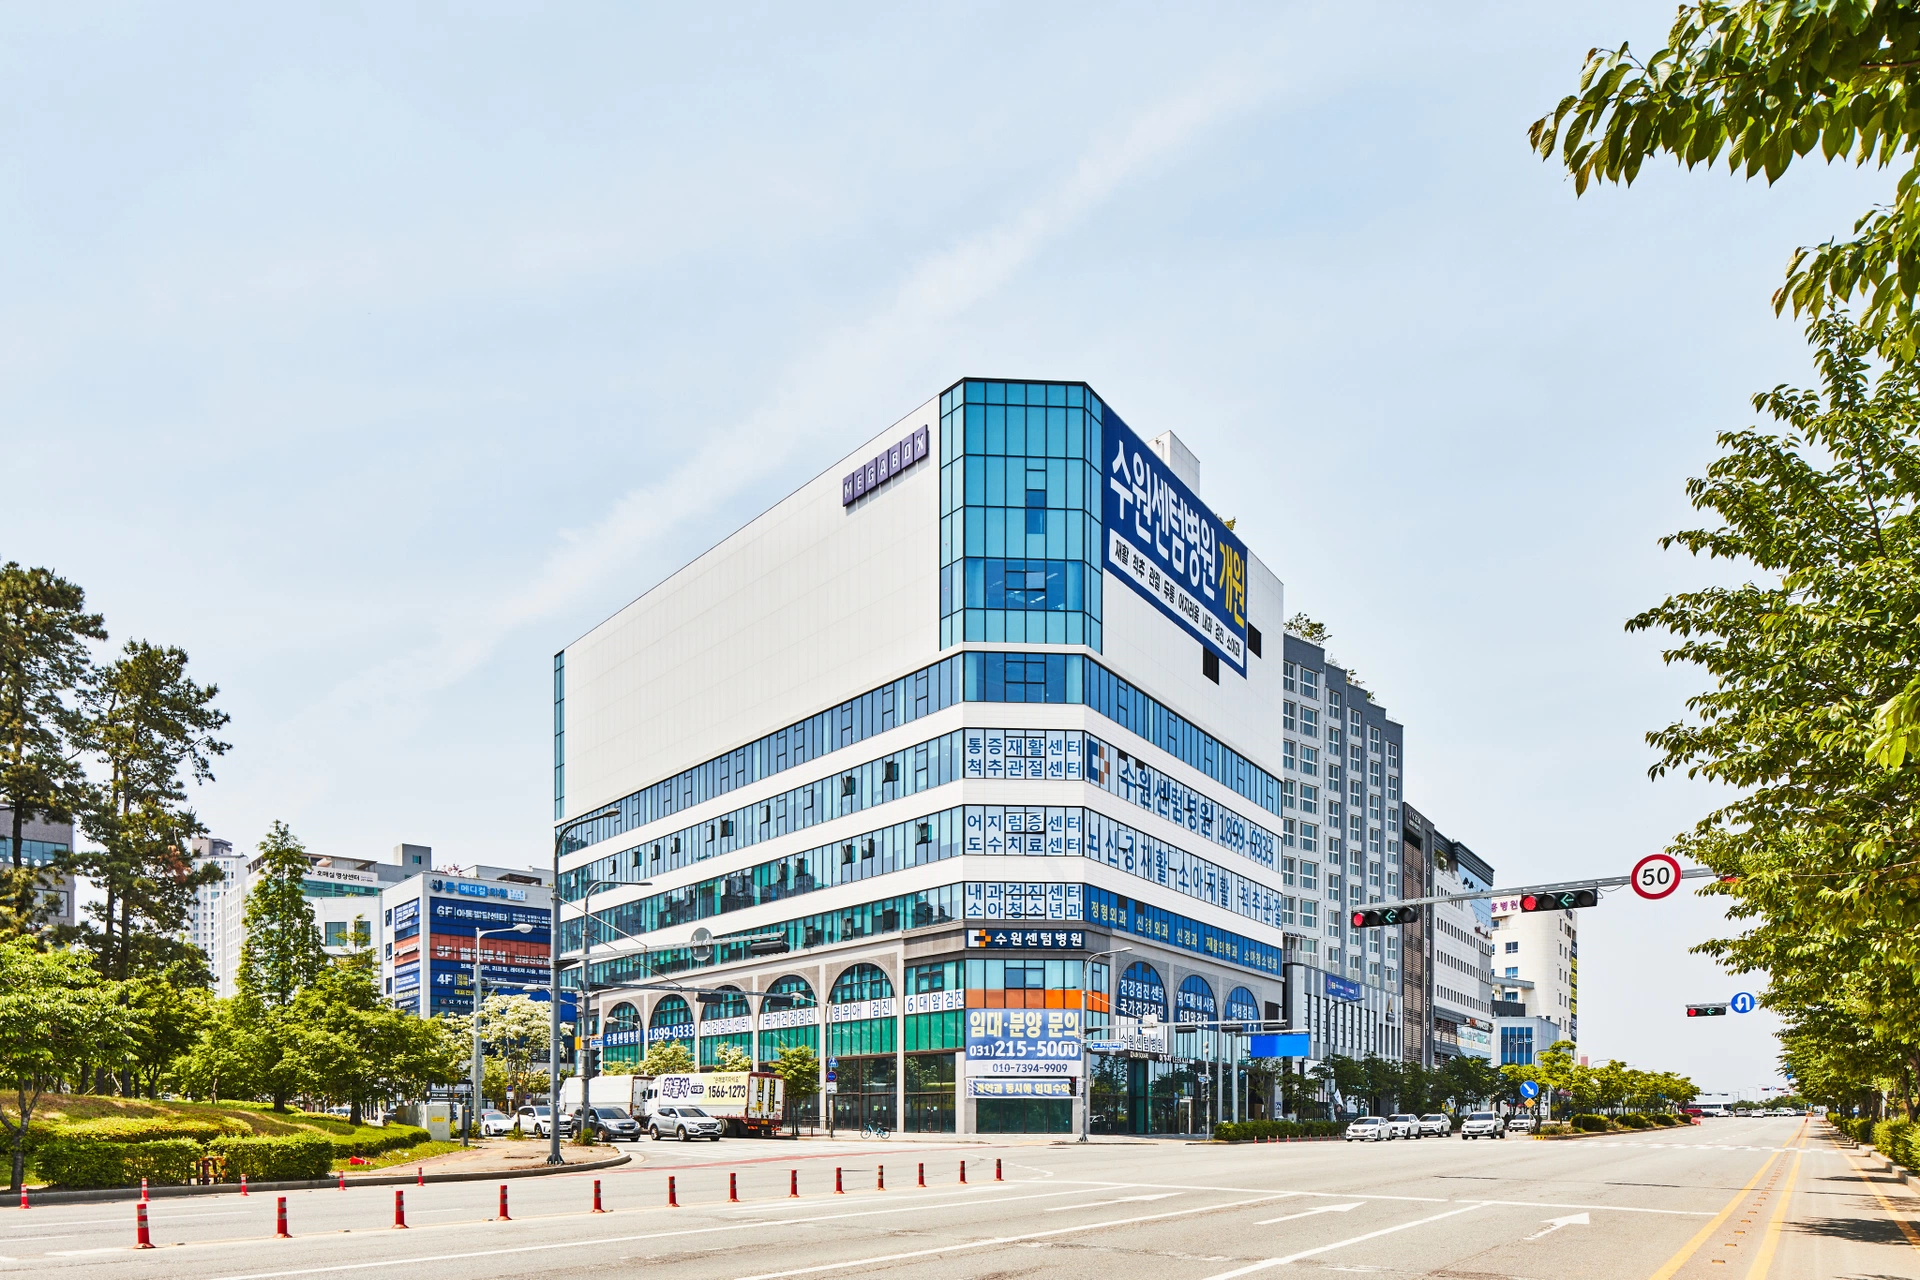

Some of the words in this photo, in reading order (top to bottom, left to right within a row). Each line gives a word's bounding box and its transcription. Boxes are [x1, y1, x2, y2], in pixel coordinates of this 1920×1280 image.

[843, 432, 925, 500] MEGABOX
[1110, 439, 1216, 601] 수원센텀병원
[1219, 541, 1245, 629] 개원
[1115, 539, 1129, 566] 재활
[1132, 554, 1145, 579] 척추
[1149, 567, 1161, 592] 관절
[1163, 580, 1175, 604] 두통
[1178, 592, 1200, 625] 어지러움
[1202, 611, 1212, 635] 내과
[967, 737, 1081, 756] 통증재활센터
[967, 758, 1081, 778] 척추관절센터
[1120, 760, 1214, 837] 수원센텀병원
[1219, 813, 1273, 864] 1899-0333
[967, 814, 1081, 833] 어지럼증센터
[967, 836, 1081, 854] 도수치료센터
[1642, 867, 1670, 886] 50
[967, 884, 1081, 902] 내과검진센터
[437, 905, 453, 918] 6F
[967, 902, 1083, 919] 소아청소년과
[1091, 901, 1127, 928] 정형외과
[1136, 916, 1168, 940] 신경외과
[1176, 929, 1197, 948] 신경과
[995, 932, 1082, 947] 수원센텀병원
[436, 945, 453, 958] 5F
[437, 974, 453, 985] 4F
[1120, 979, 1164, 1003] 건강검진센터
[908, 990, 964, 1012] 6대암검진
[1120, 998, 1164, 1021] 국가건강검진
[764, 1010, 813, 1027] 국가건강검진
[833, 1005, 860, 1021] 영유아
[872, 1000, 890, 1017] 검진
[648, 1023, 695, 1041] 1899-0333
[705, 1018, 748, 1035] 건강검진센터
[969, 1011, 1042, 1038] 임대·분양
[1048, 1012, 1079, 1038] 문의
[606, 1029, 640, 1044] 수원센텀병원
[969, 1040, 1079, 1057] 031)215-5000
[992, 1063, 1068, 1073] 010-7394-9909
[662, 1077, 690, 1099] 화물차
[708, 1084, 746, 1098] 1566-1273
[1005, 1083, 1032, 1095] 동시에
